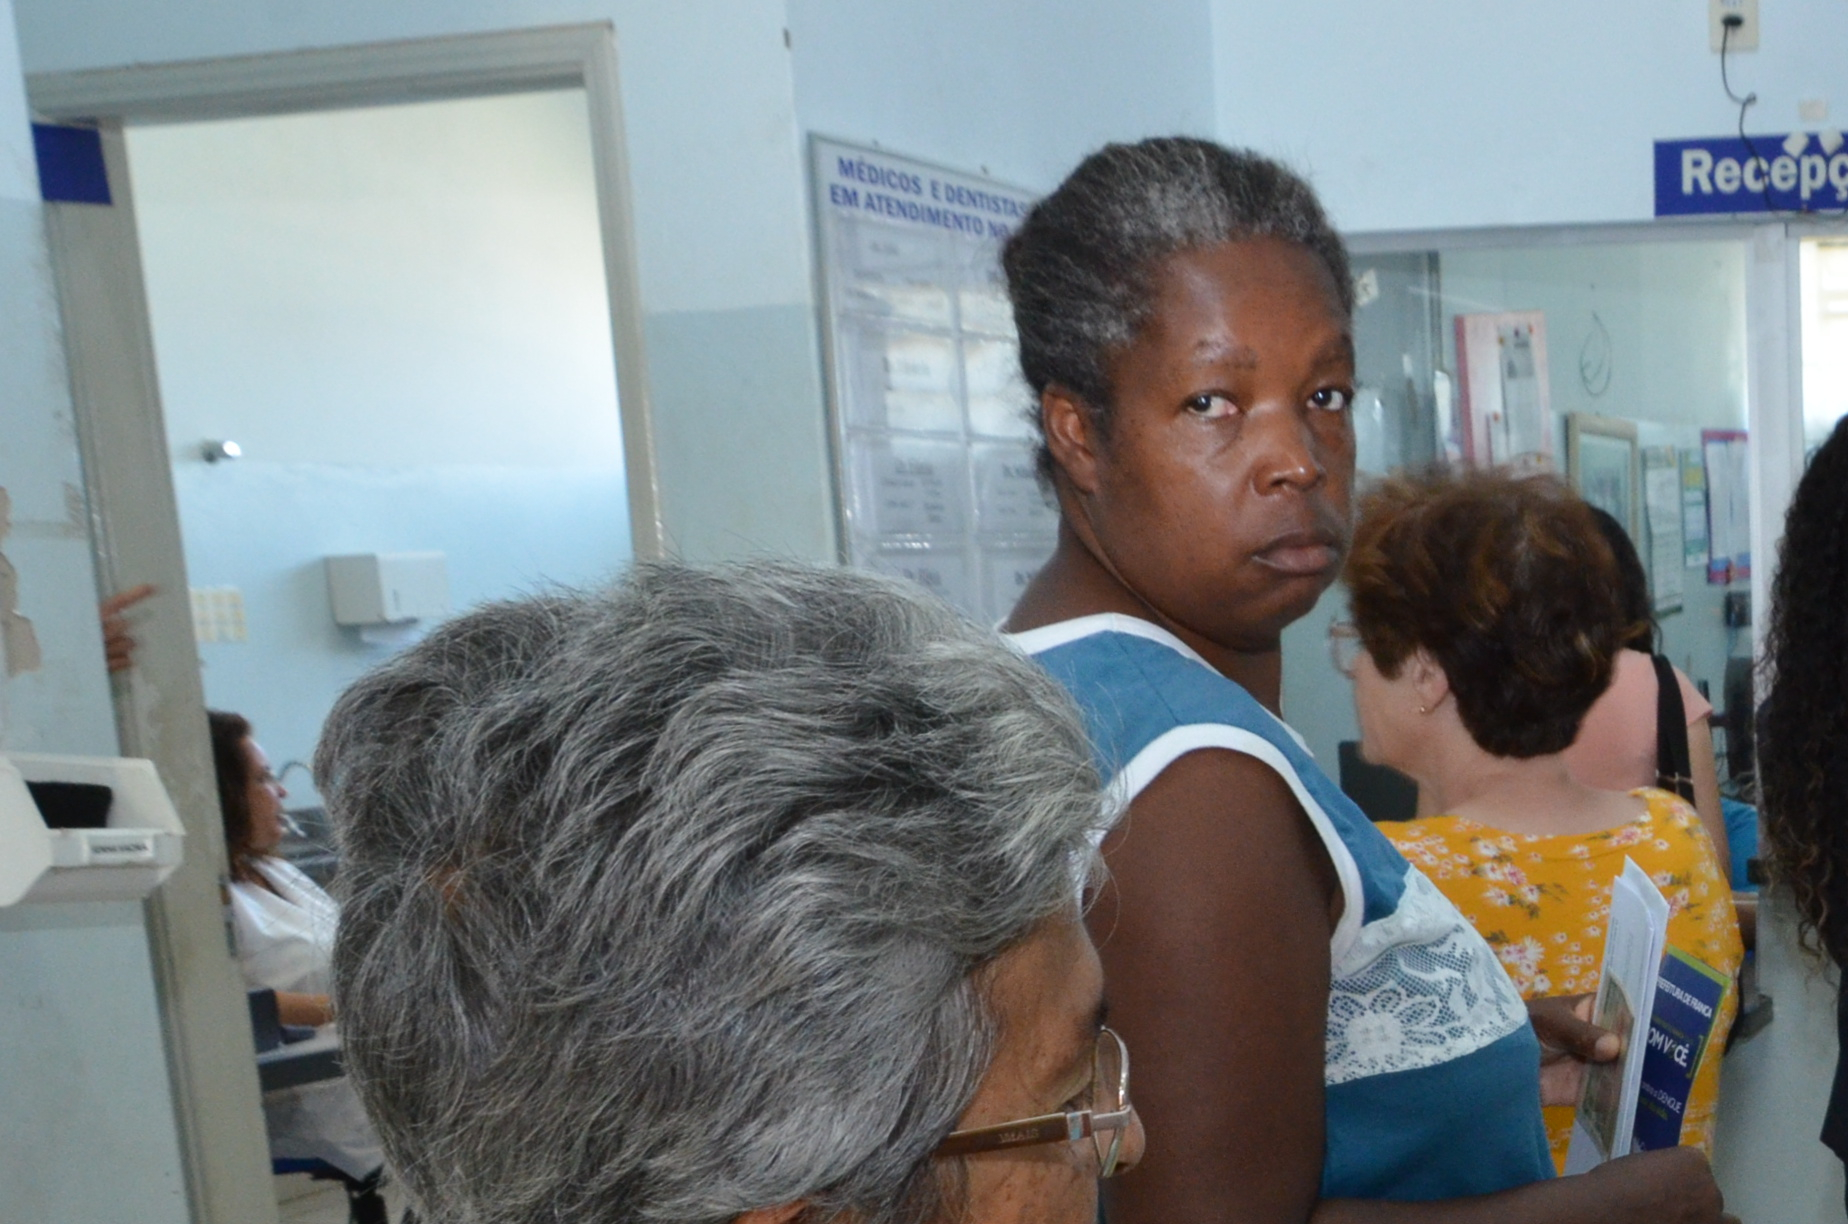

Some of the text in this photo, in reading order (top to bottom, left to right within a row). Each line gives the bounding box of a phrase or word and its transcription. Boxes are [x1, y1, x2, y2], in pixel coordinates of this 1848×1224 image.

[837, 154, 923, 196] MÉDICOS
[929, 180, 941, 200] E
[829, 183, 859, 207] EM
[864, 193, 984, 235] ATENDIMENTO
